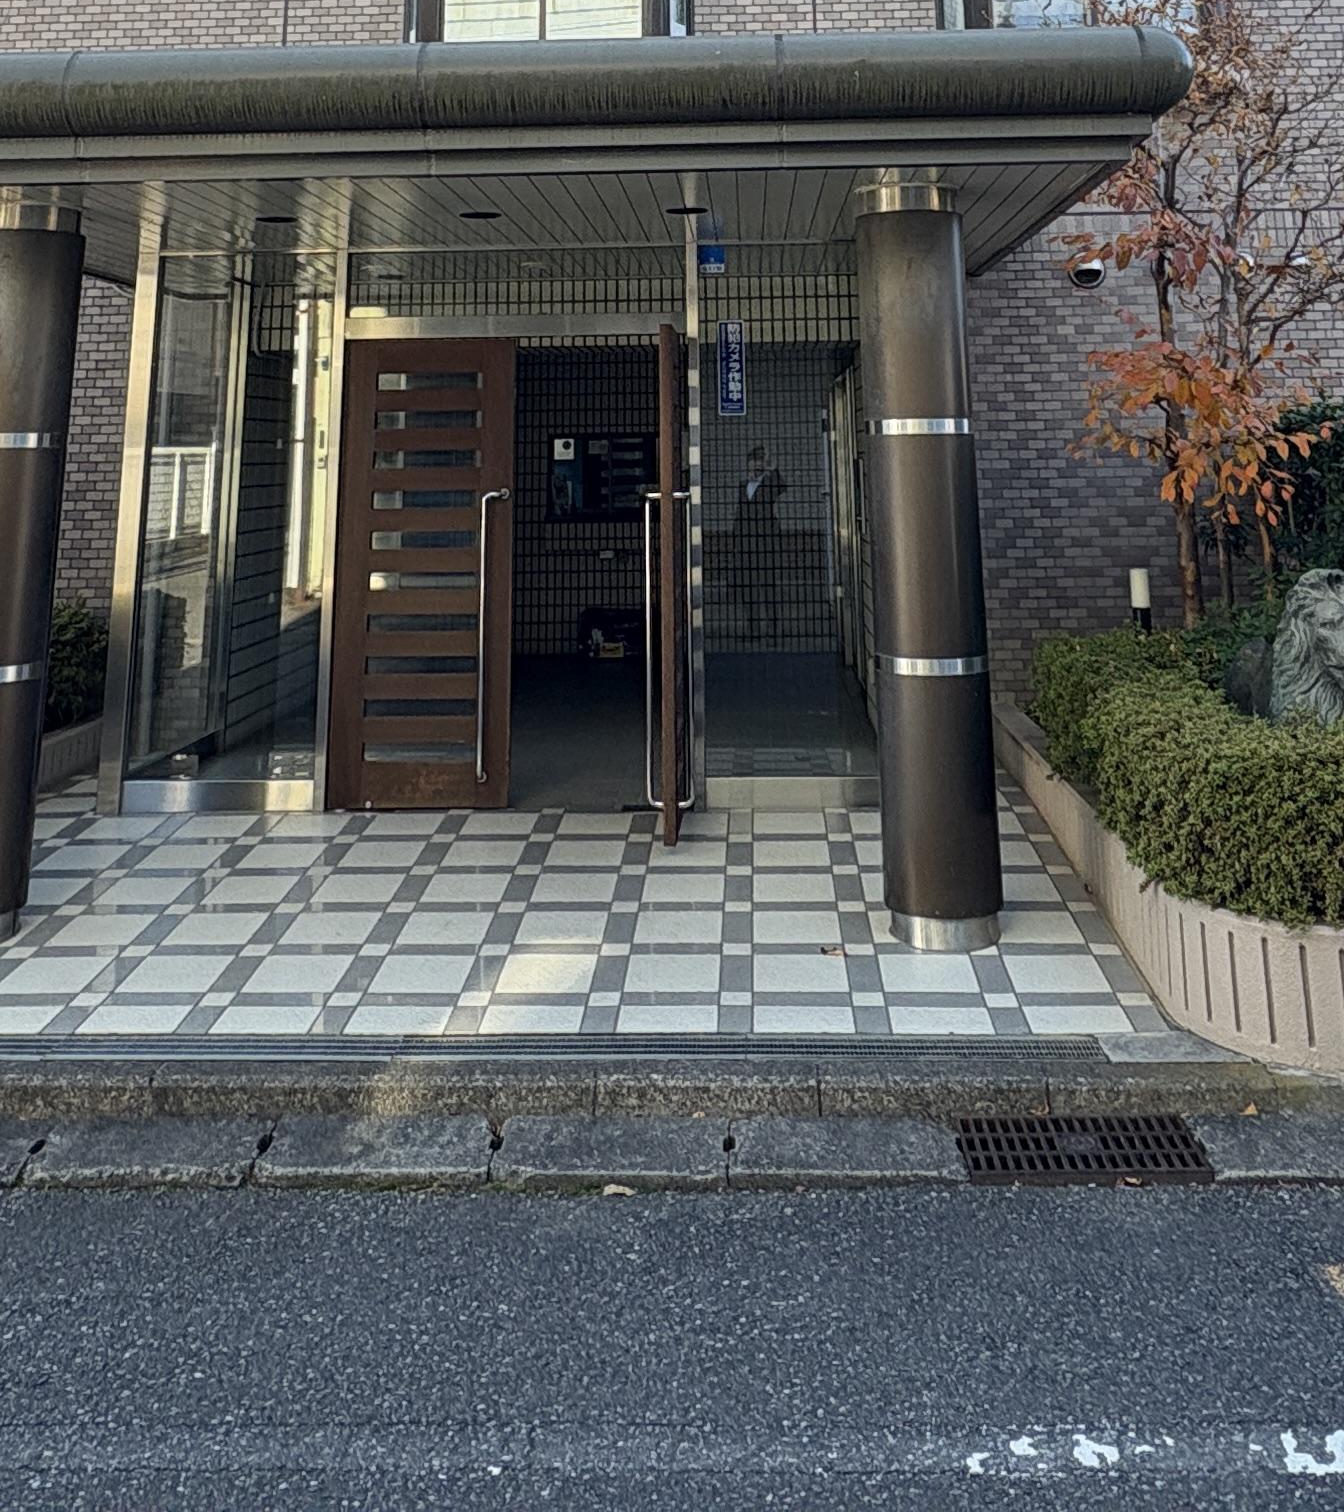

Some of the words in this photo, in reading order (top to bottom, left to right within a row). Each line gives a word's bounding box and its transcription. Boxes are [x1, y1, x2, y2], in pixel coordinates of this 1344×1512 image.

[727, 323, 742, 402] 防犯カメラ作動中
